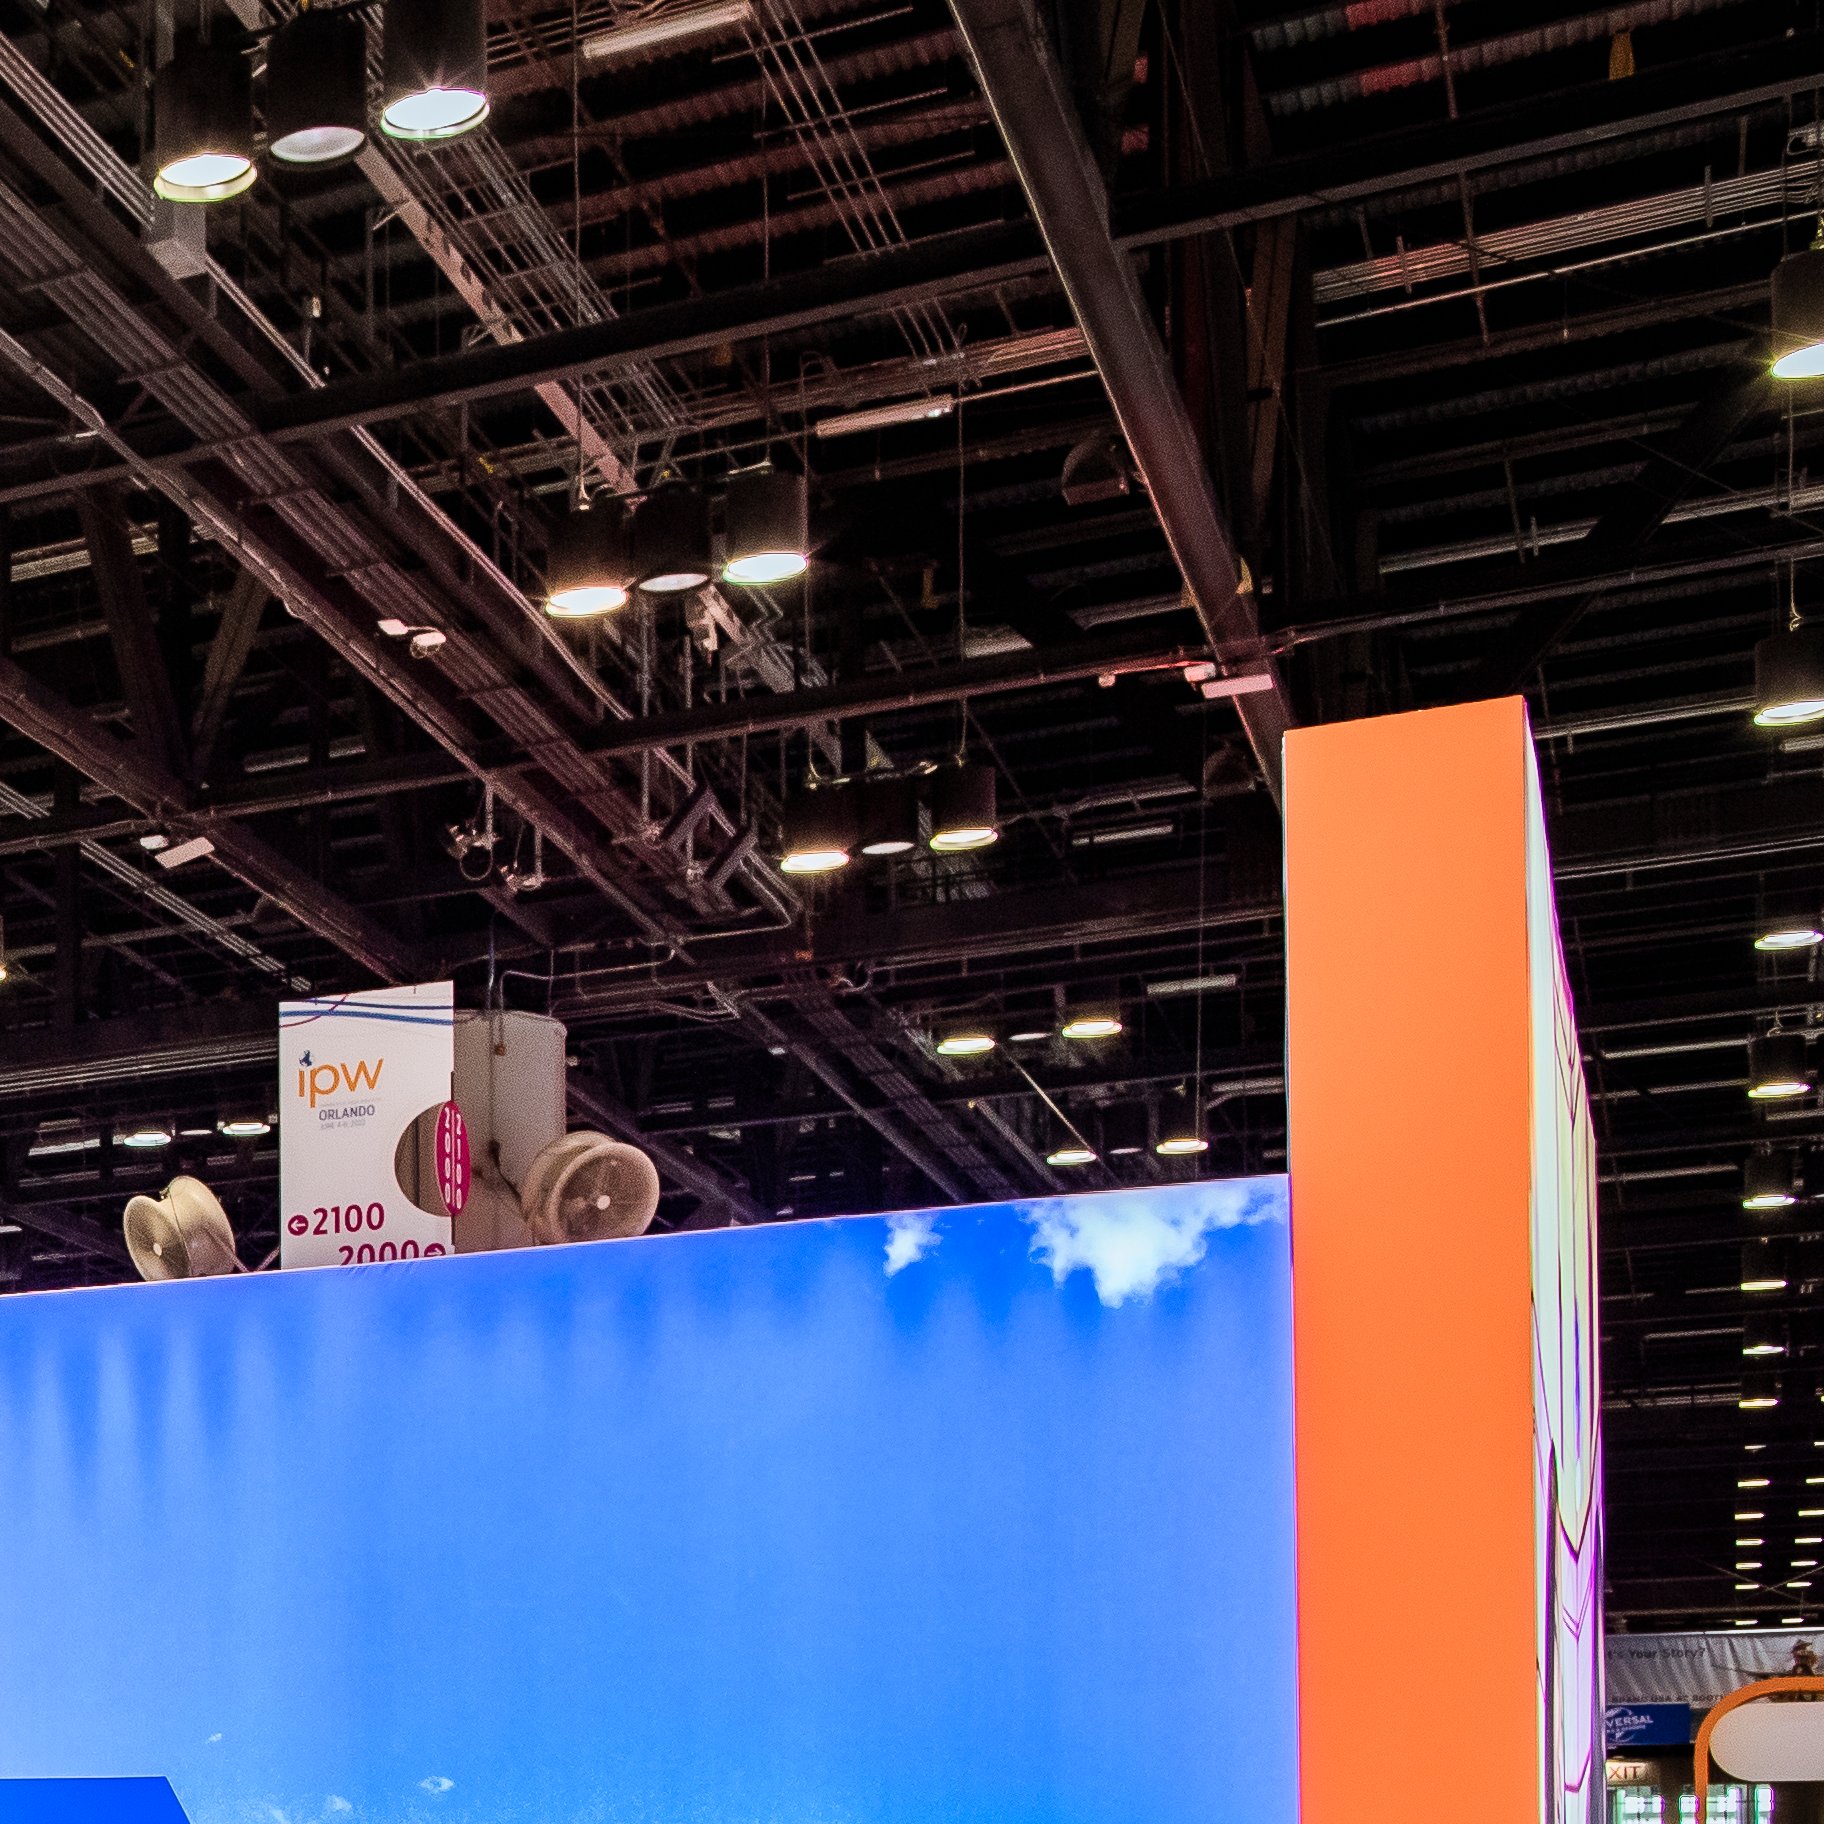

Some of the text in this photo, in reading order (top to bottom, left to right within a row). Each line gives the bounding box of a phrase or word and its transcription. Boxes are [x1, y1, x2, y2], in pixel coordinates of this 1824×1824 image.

[298, 1051, 385, 1109] ipw
[318, 1104, 376, 1121] ORLANDO
[312, 1202, 385, 1236] 2100
